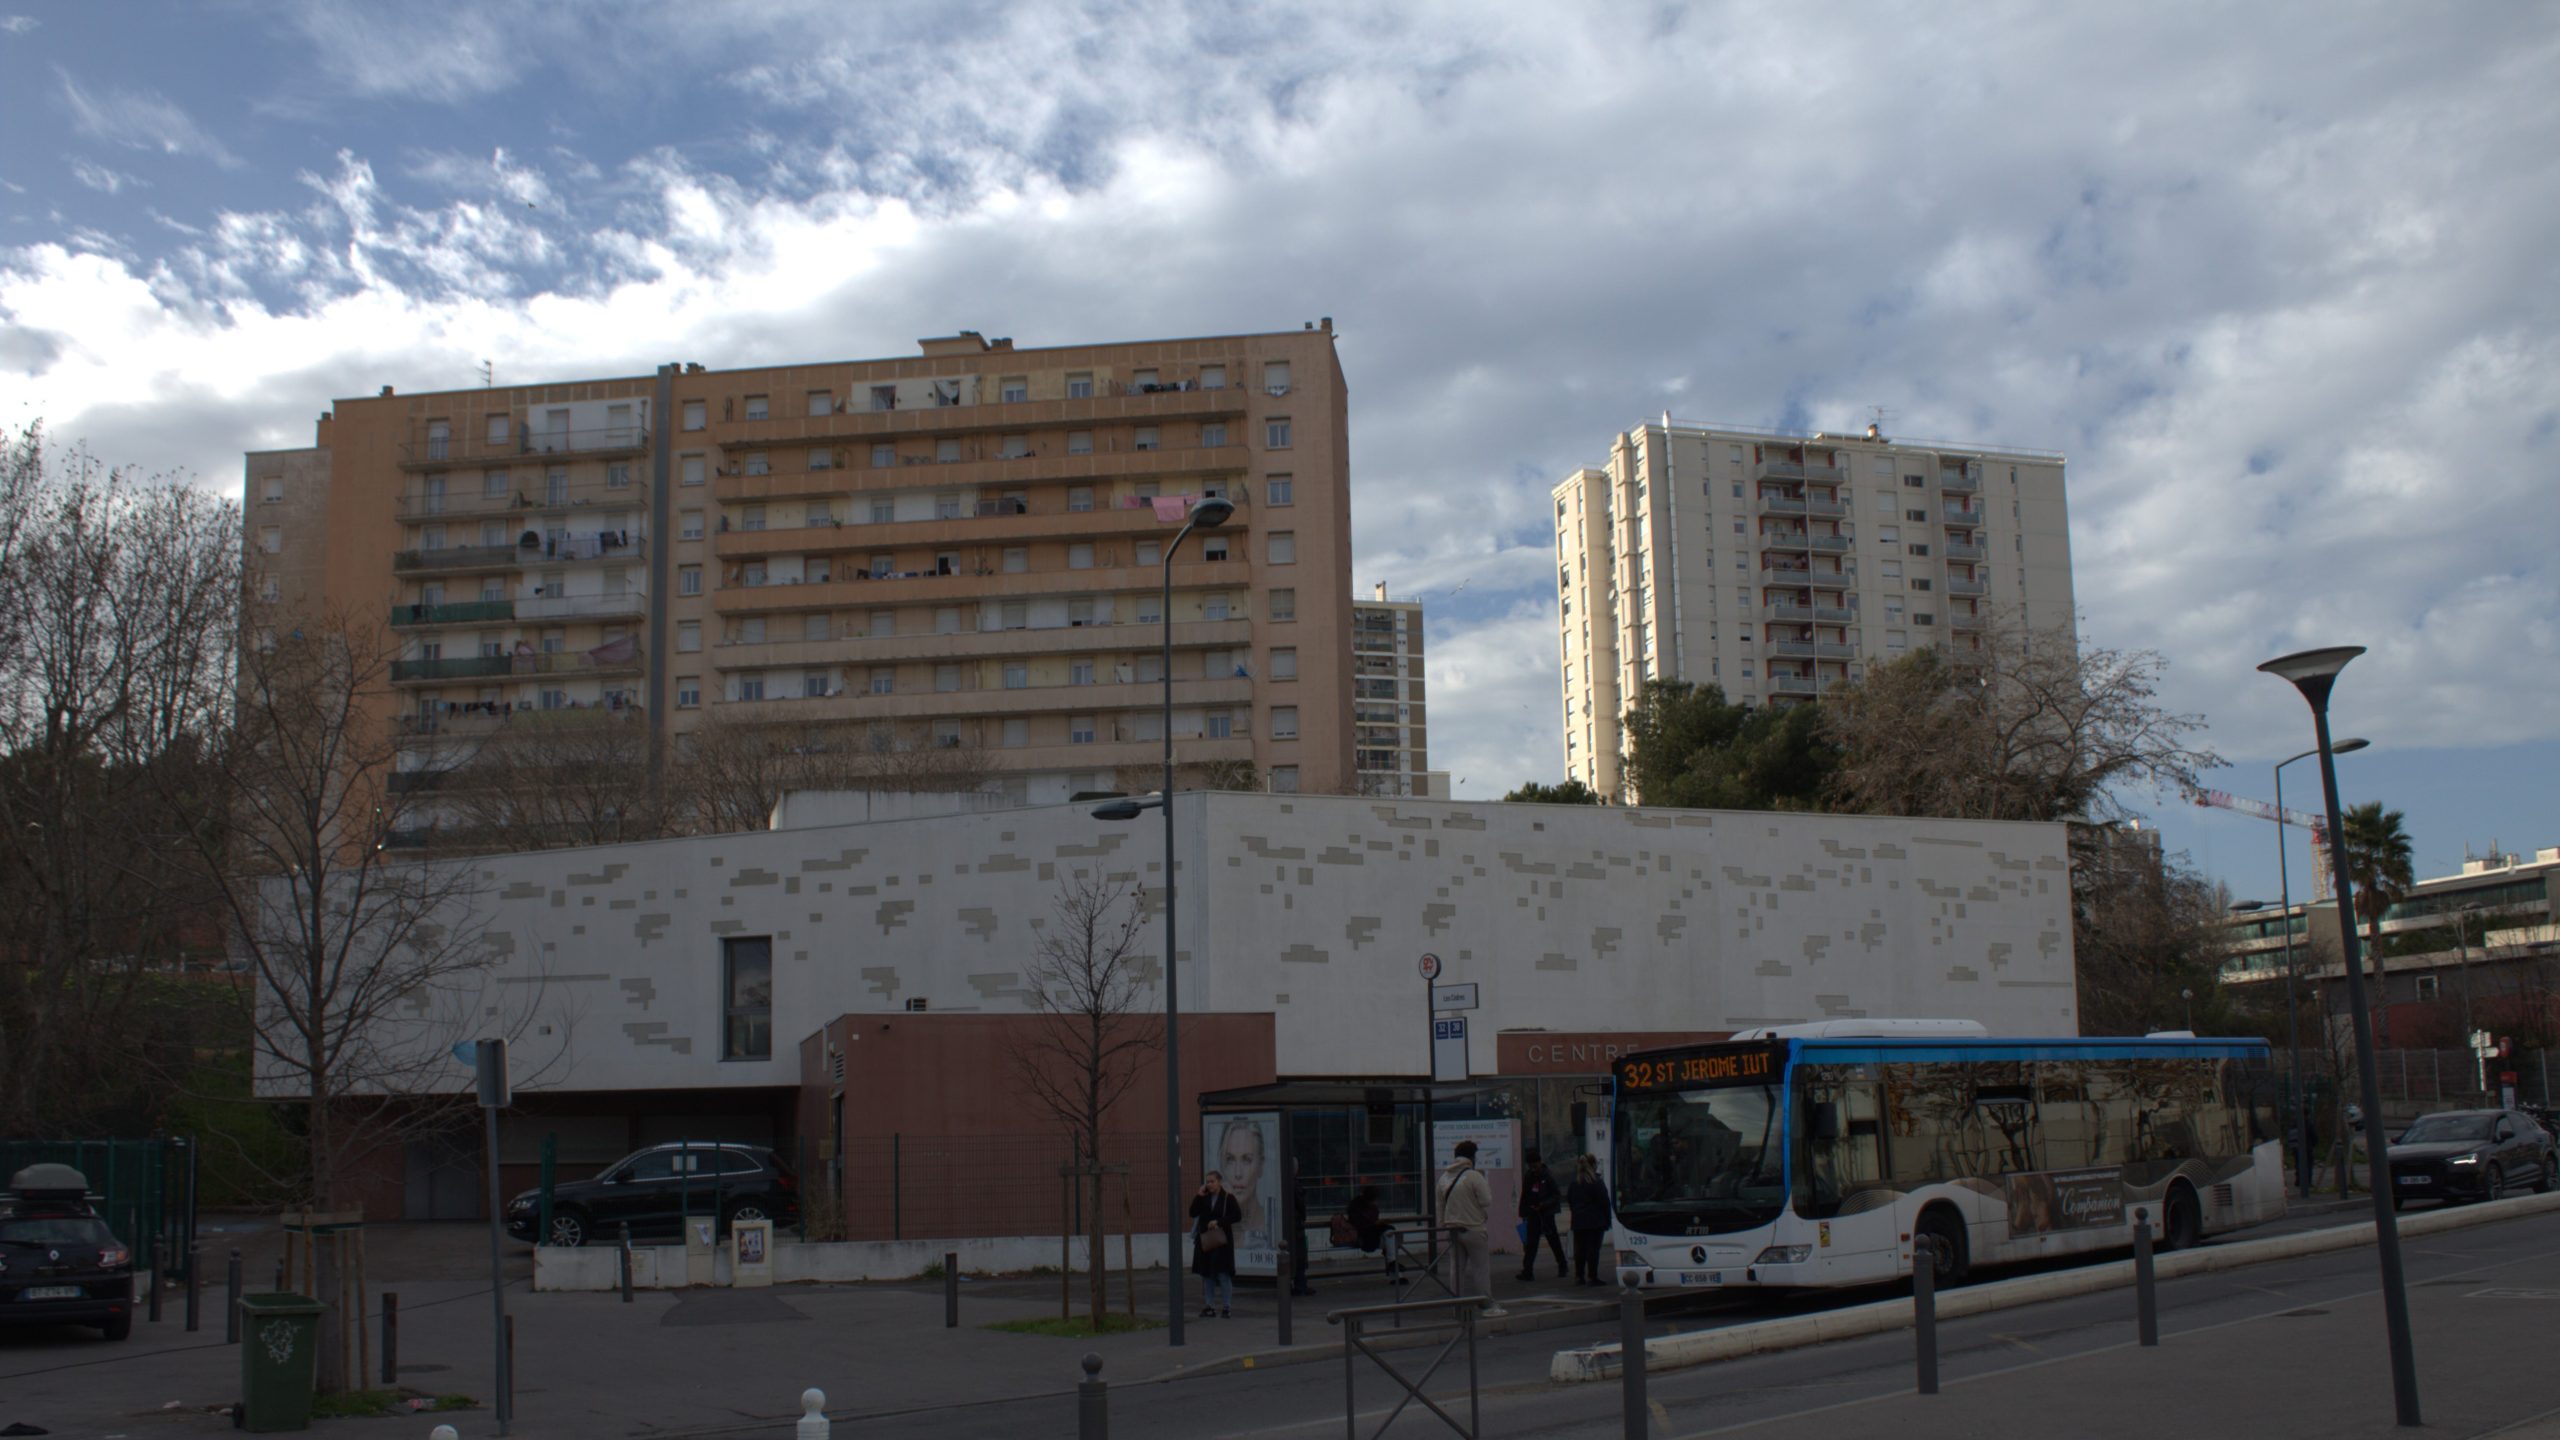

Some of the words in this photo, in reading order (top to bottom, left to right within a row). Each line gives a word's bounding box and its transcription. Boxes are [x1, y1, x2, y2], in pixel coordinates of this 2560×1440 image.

[1624, 1062, 1653, 1088] 32
[1656, 1062, 1675, 1082] ST
[1681, 1055, 1738, 1081] JEROME
[1742, 1052, 1770, 1076] IUT
[2063, 1187, 2121, 1222] Companion
[1629, 1236, 1647, 1245] 1293
[1250, 1252, 1274, 1265] DIOR
